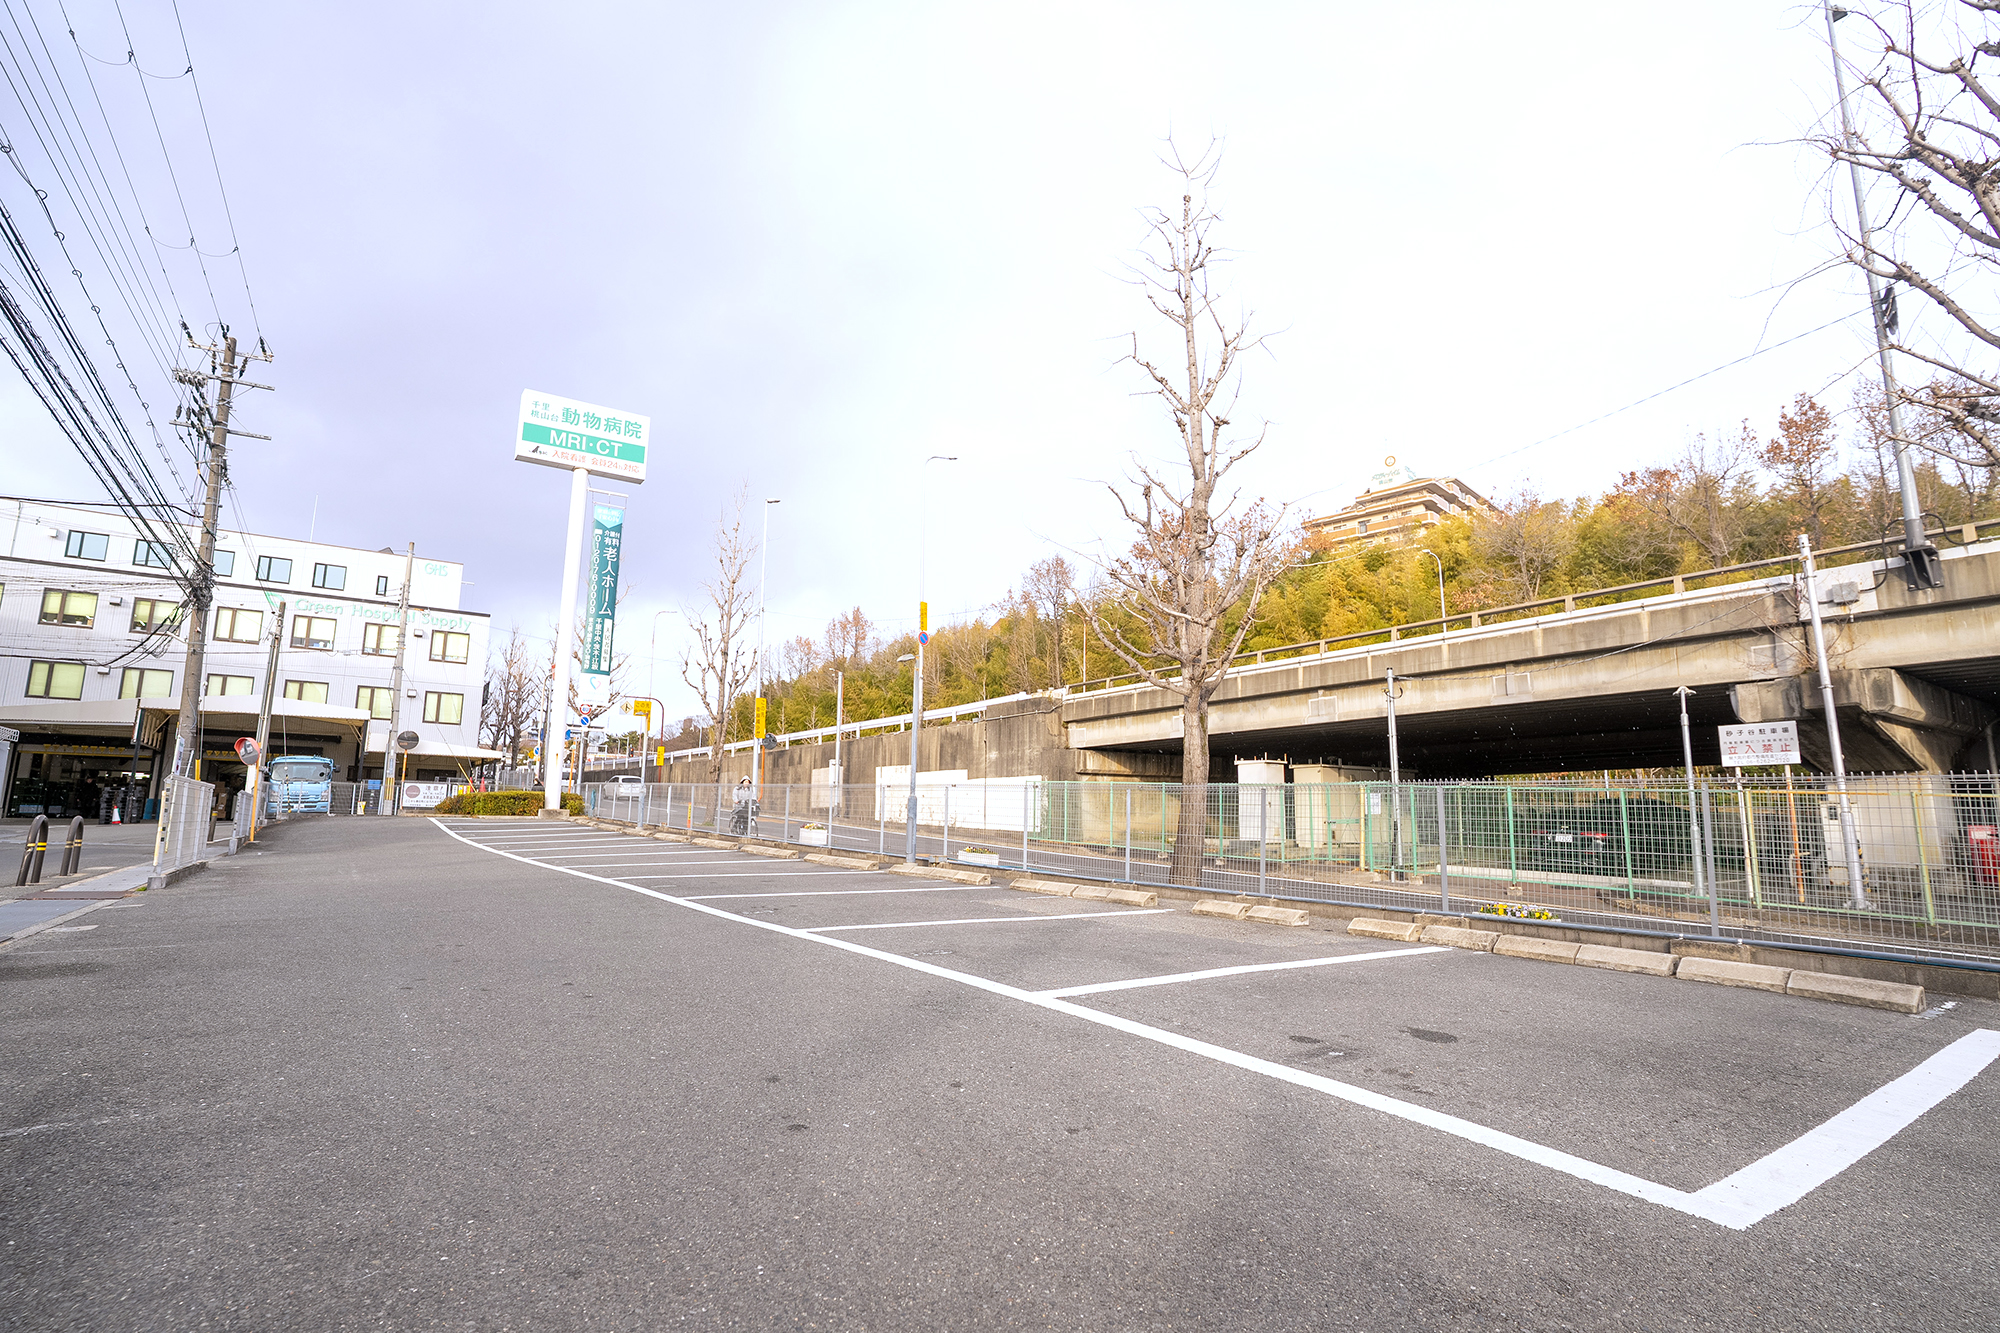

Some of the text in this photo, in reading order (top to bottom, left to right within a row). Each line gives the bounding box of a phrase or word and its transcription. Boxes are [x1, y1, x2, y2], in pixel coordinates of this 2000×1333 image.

[530, 410, 559, 422] 桃山台
[562, 406, 642, 439] 動物病院
[424, 562, 448, 577] GHS
[598, 547, 618, 616] 老人ホーム
[295, 598, 344, 616] Green
[422, 610, 472, 632] Supply
[1728, 743, 1791, 755] 立入禁止
